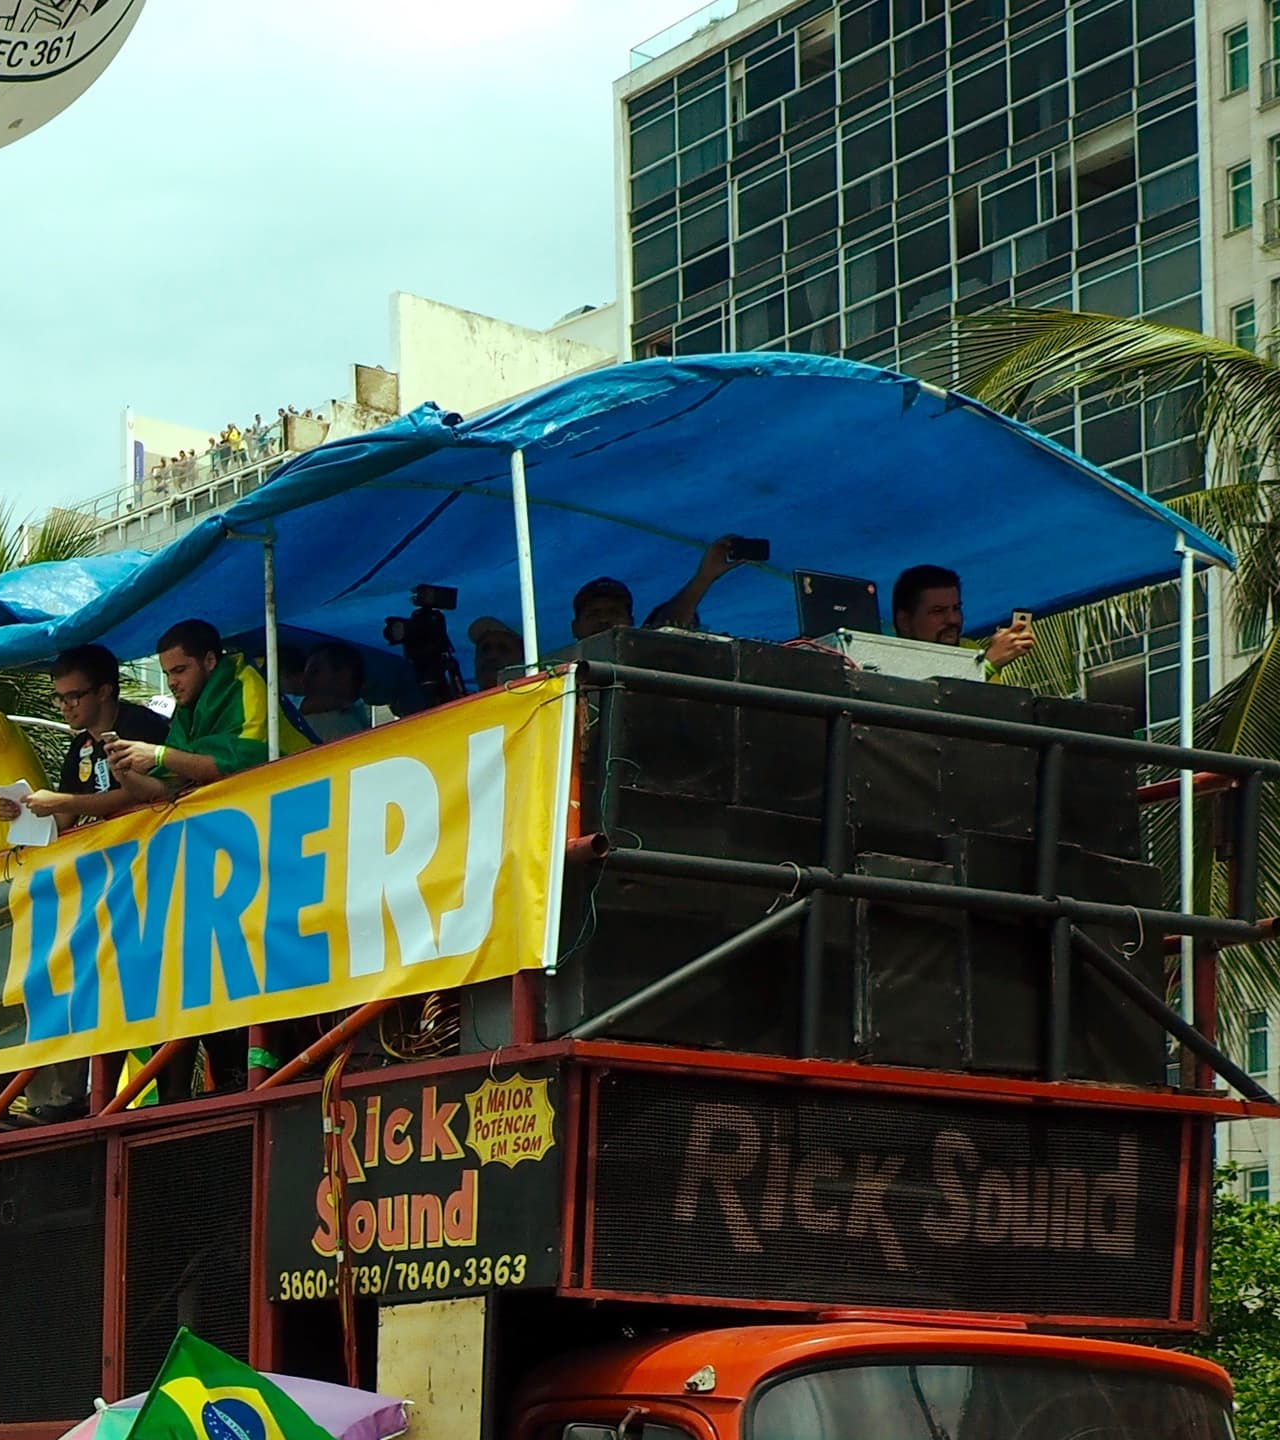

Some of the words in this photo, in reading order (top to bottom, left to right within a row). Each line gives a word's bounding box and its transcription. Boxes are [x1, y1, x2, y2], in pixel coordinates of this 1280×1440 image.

[30, 31, 76, 67] 361
[24, 778, 330, 1043] LIVRE
[347, 725, 506, 978] RJ
[323, 1086, 465, 1183] Rick
[474, 1098, 484, 1117] A
[487, 1087, 533, 1114] MAIOR
[490, 1139, 507, 1160] EM
[512, 1135, 542, 1154] SOM
[311, 1169, 478, 1257] Sound
[921, 1127, 1138, 1257] Sound
